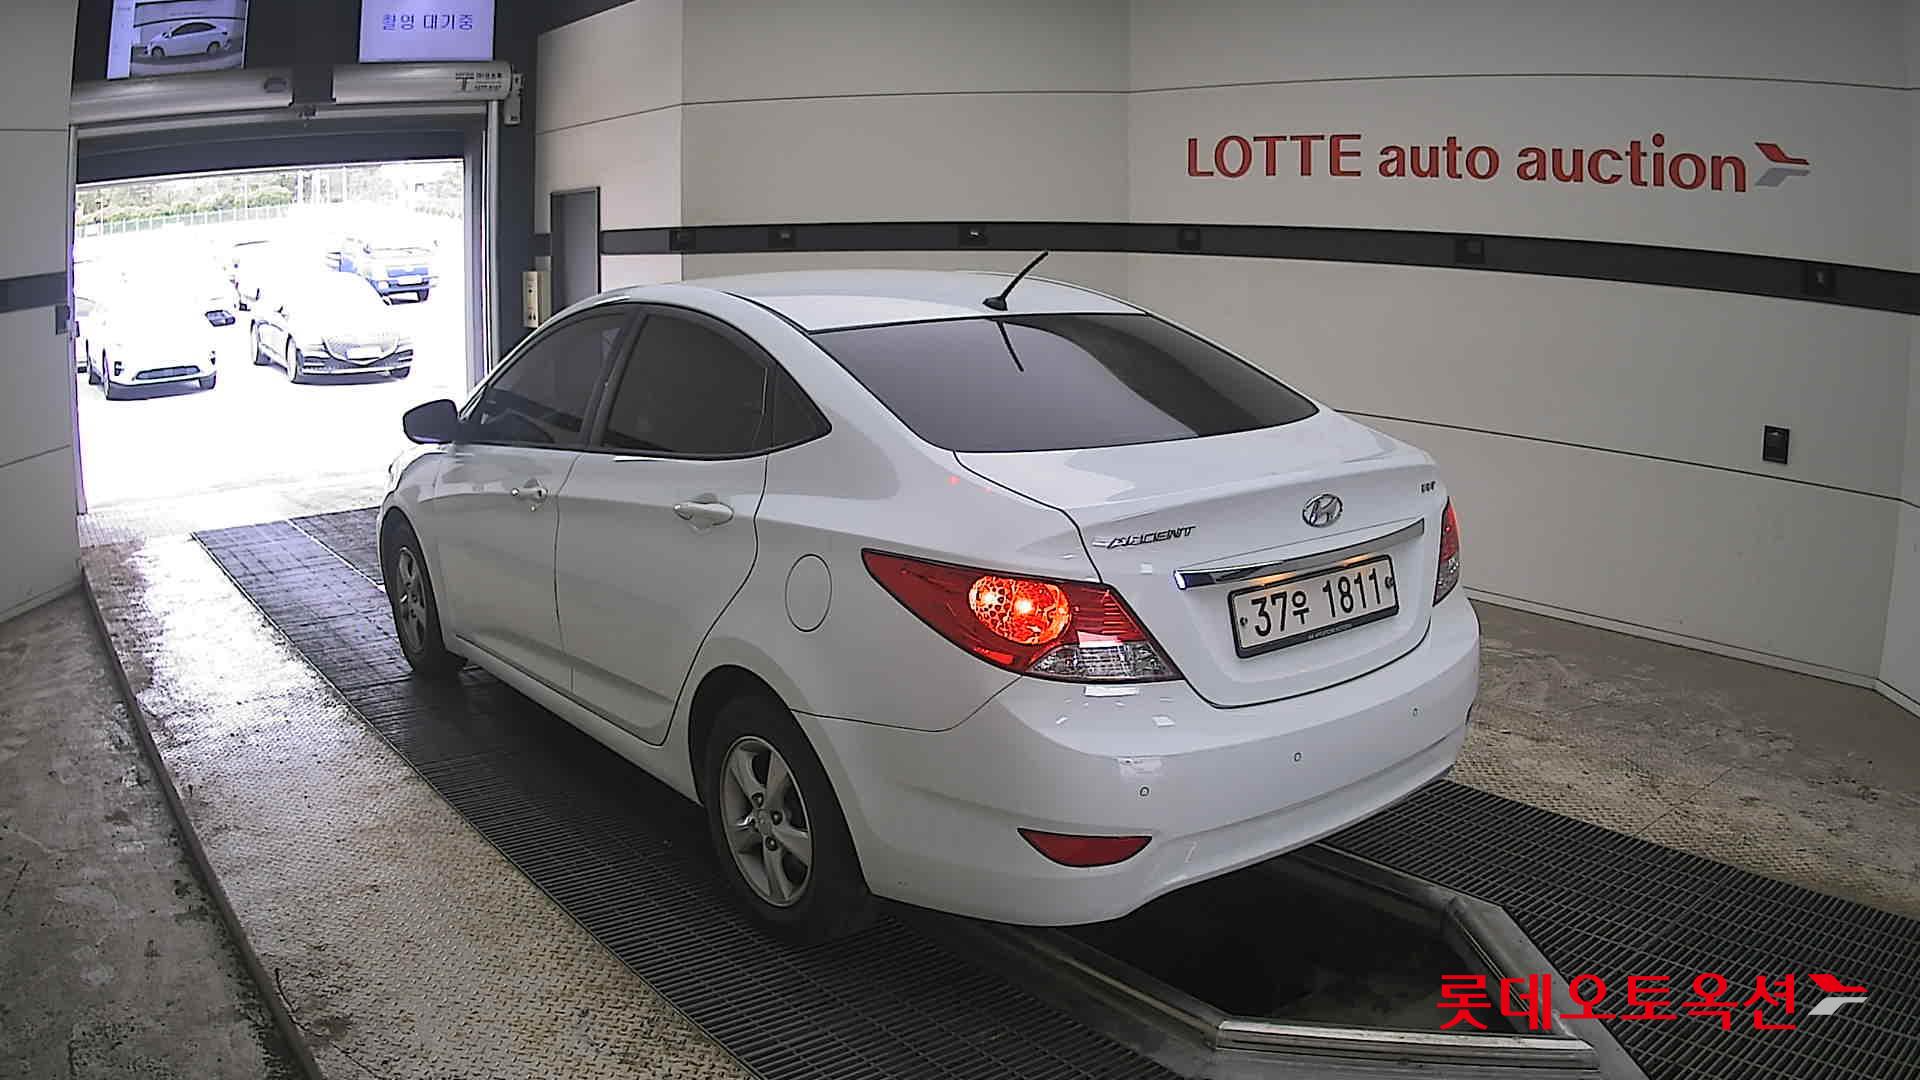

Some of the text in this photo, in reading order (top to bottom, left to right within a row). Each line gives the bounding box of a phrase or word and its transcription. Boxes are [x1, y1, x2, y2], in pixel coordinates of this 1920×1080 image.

[383, 14, 473, 31] 촬영 대기중
[1188, 134, 1746, 192] LOTTE auto auction
[1104, 526, 1196, 549] ACCENT
[1251, 568, 1381, 637] 37우 1811
